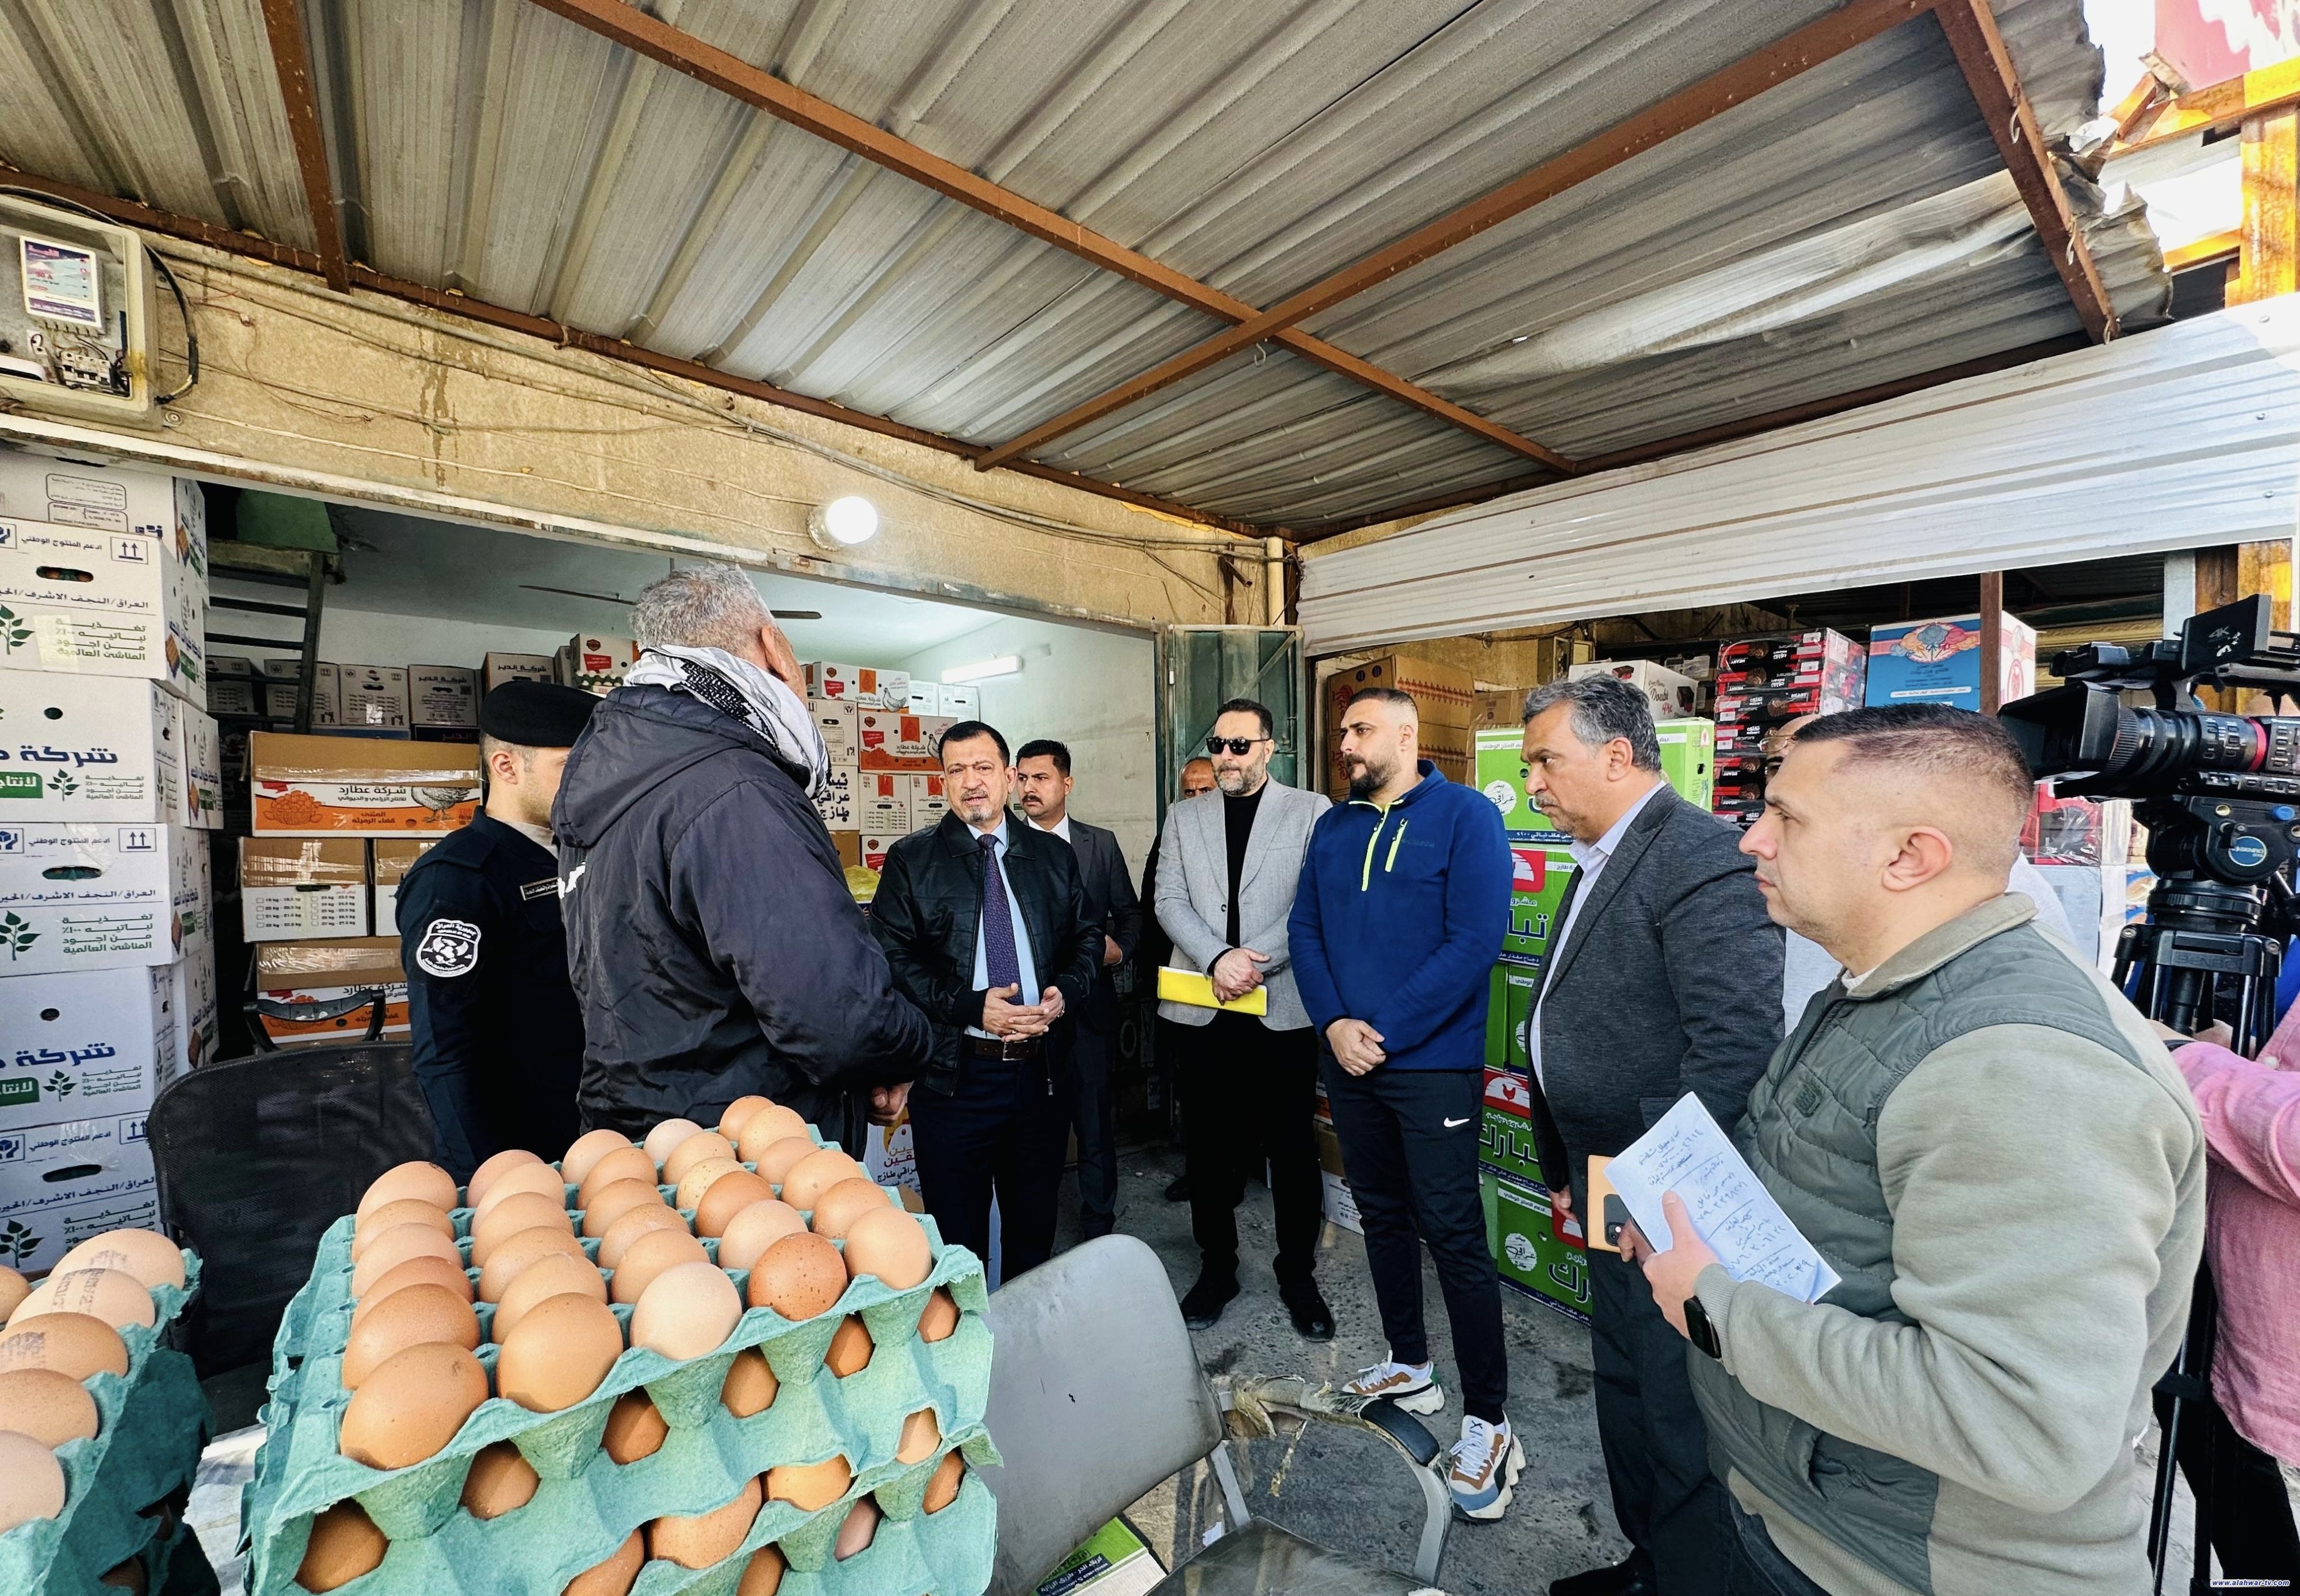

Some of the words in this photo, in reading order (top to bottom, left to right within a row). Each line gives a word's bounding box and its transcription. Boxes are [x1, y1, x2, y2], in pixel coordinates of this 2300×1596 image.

[520, 665, 547, 673] شركة
[441, 676, 467, 684] شركة
[20, 745, 118, 768] شركة
[338, 785, 371, 796] عطارد
[374, 785, 407, 797] شركة
[817, 790, 850, 806] عراقي
[820, 806, 850, 820] طازج
[62, 913, 154, 924] تغذية
[1507, 908, 1549, 944] تبا
[110, 934, 152, 943] من
[16, 1042, 116, 1067] شركة
[877, 1171, 896, 1182] طازج
[1088, 1555, 1103, 1567] كربلاء
